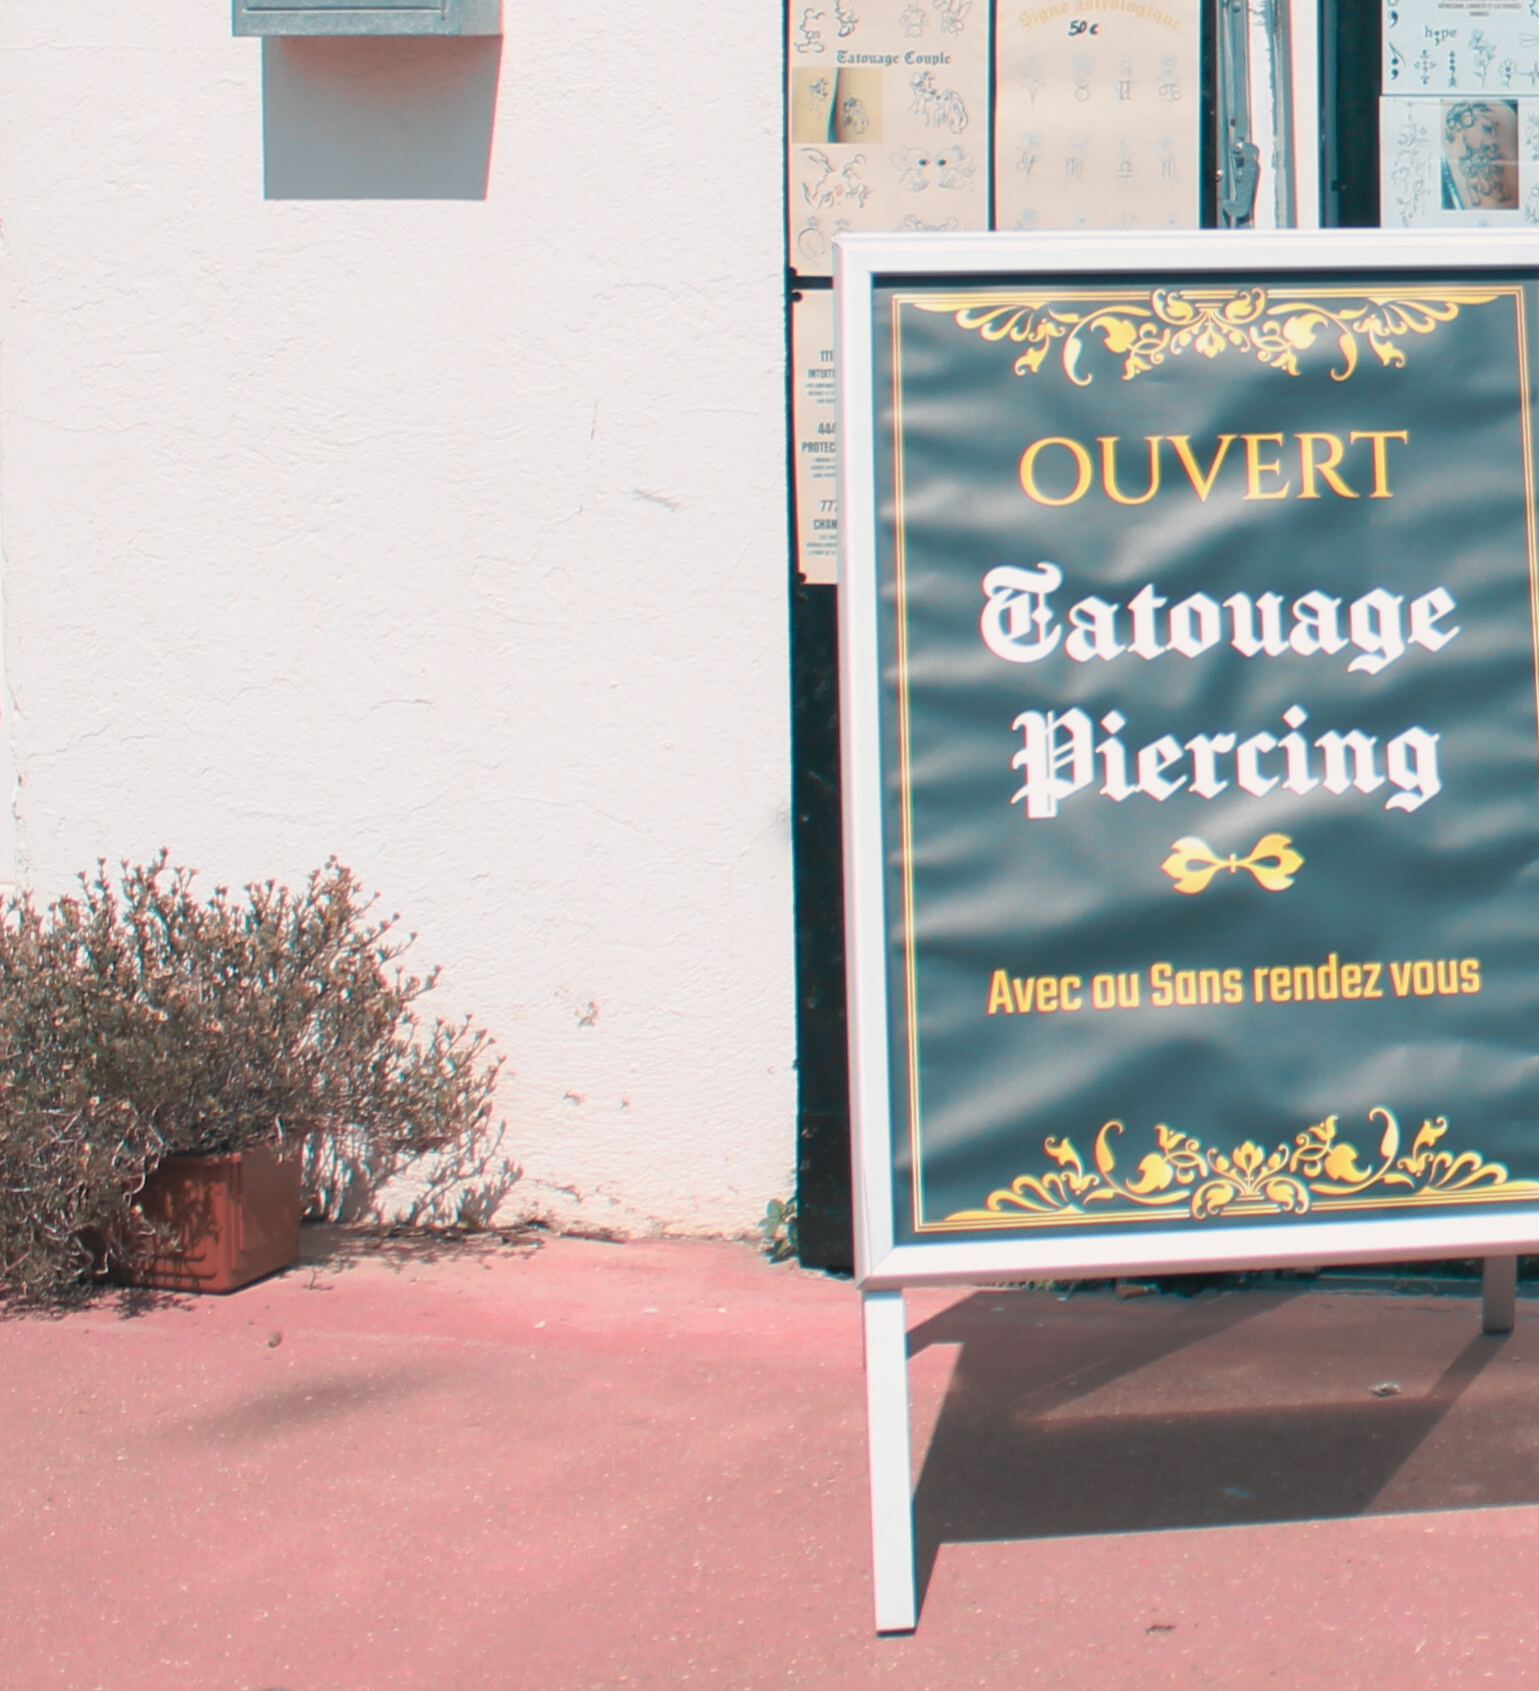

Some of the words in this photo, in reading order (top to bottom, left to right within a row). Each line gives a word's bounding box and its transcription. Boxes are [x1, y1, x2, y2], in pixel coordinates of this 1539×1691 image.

[836, 51, 899, 67] Tatouage
[904, 51, 950, 65] Couple
[802, 440, 837, 454] PROTEC
[1019, 429, 1407, 505] OUVERT
[813, 518, 838, 531] CHAN
[981, 561, 1461, 673] Tatouage
[1009, 704, 1441, 818] Piercing
[989, 967, 1080, 1016] Avec
[1093, 968, 1139, 1009] ou
[1151, 960, 1241, 1007] Sans
[1254, 953, 1382, 1002] rendez
[1390, 957, 1481, 997] vous
